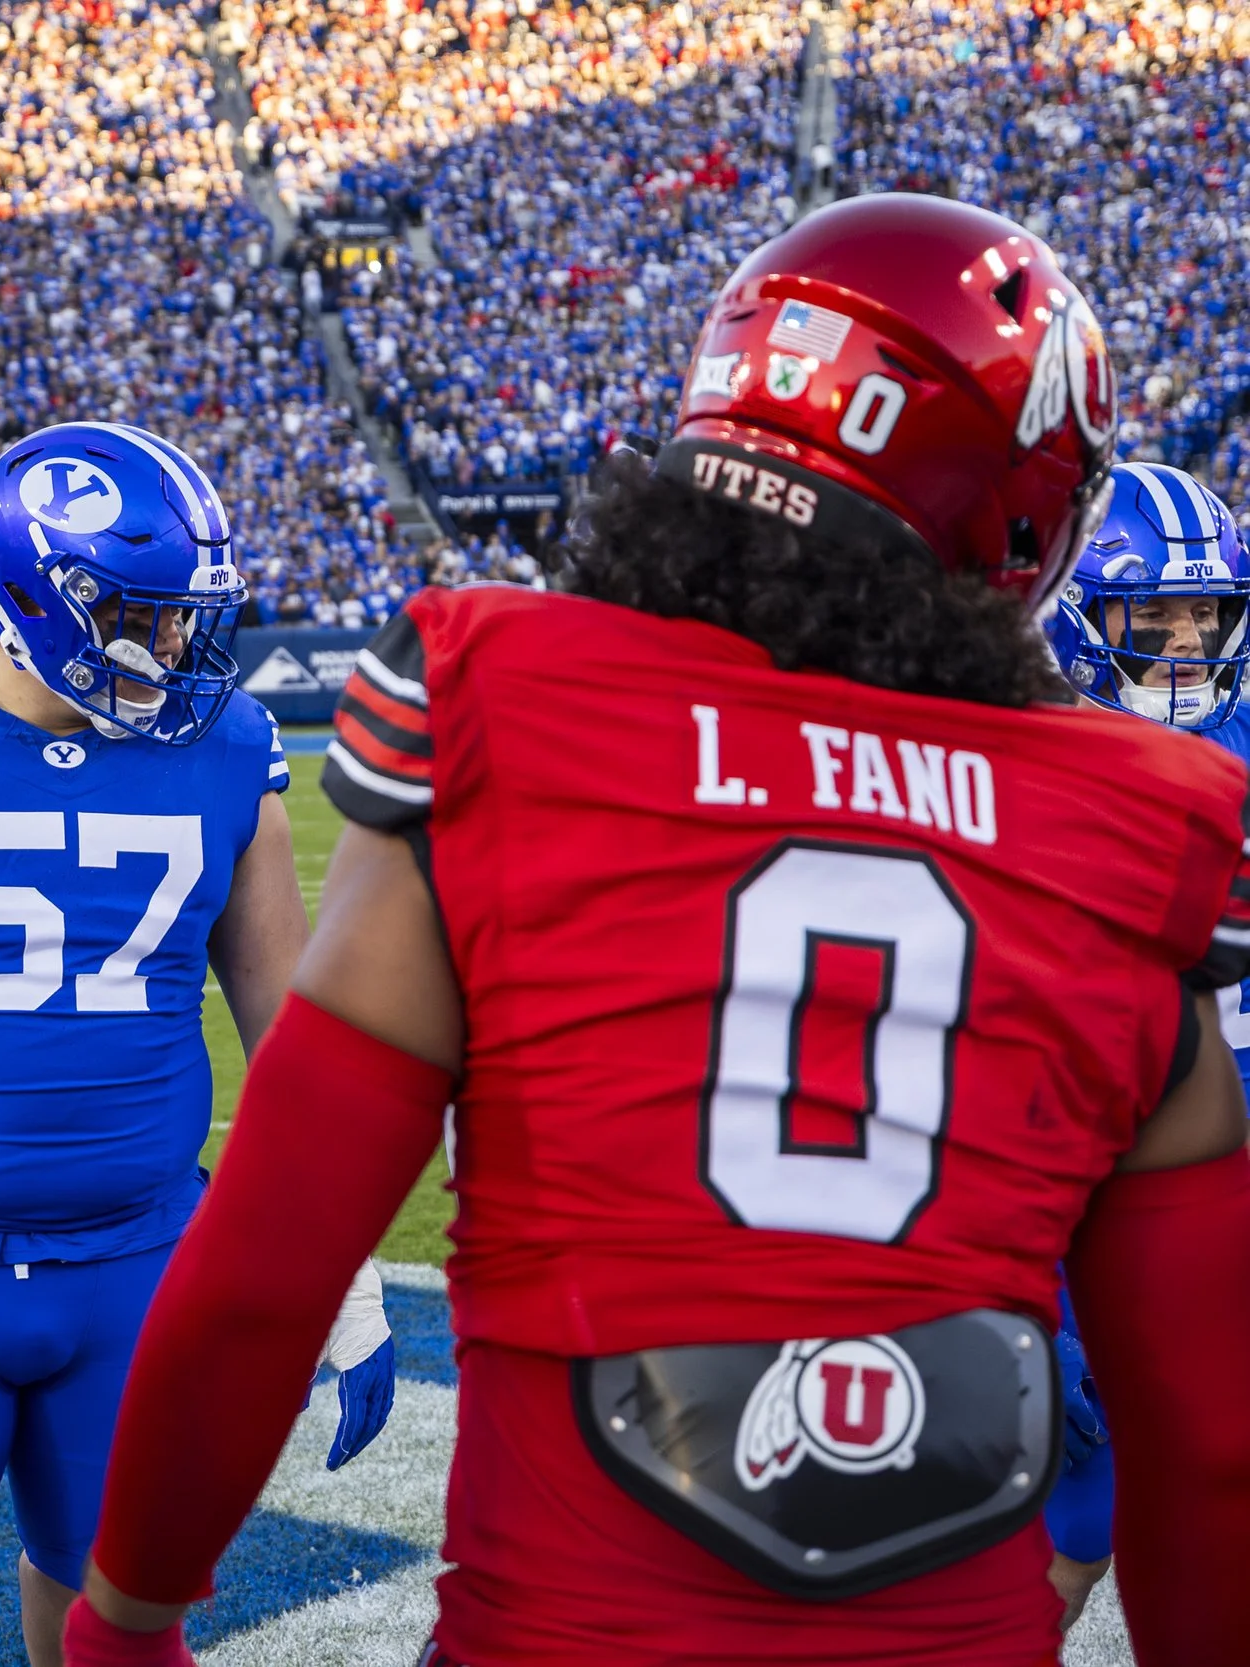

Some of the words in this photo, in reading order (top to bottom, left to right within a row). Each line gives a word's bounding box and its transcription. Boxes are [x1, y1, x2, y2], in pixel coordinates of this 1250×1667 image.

[838, 372, 908, 456] 0
[39, 462, 110, 522] Y
[693, 452, 819, 527] UTES
[210, 569, 229, 586] BYU
[1184, 563, 1213, 578] BYU
[49, 745, 77, 764] Y
[691, 704, 768, 805] L.
[800, 721, 997, 845] FANO
[697, 835, 976, 1245] 0
[819, 1361, 895, 1448] U
